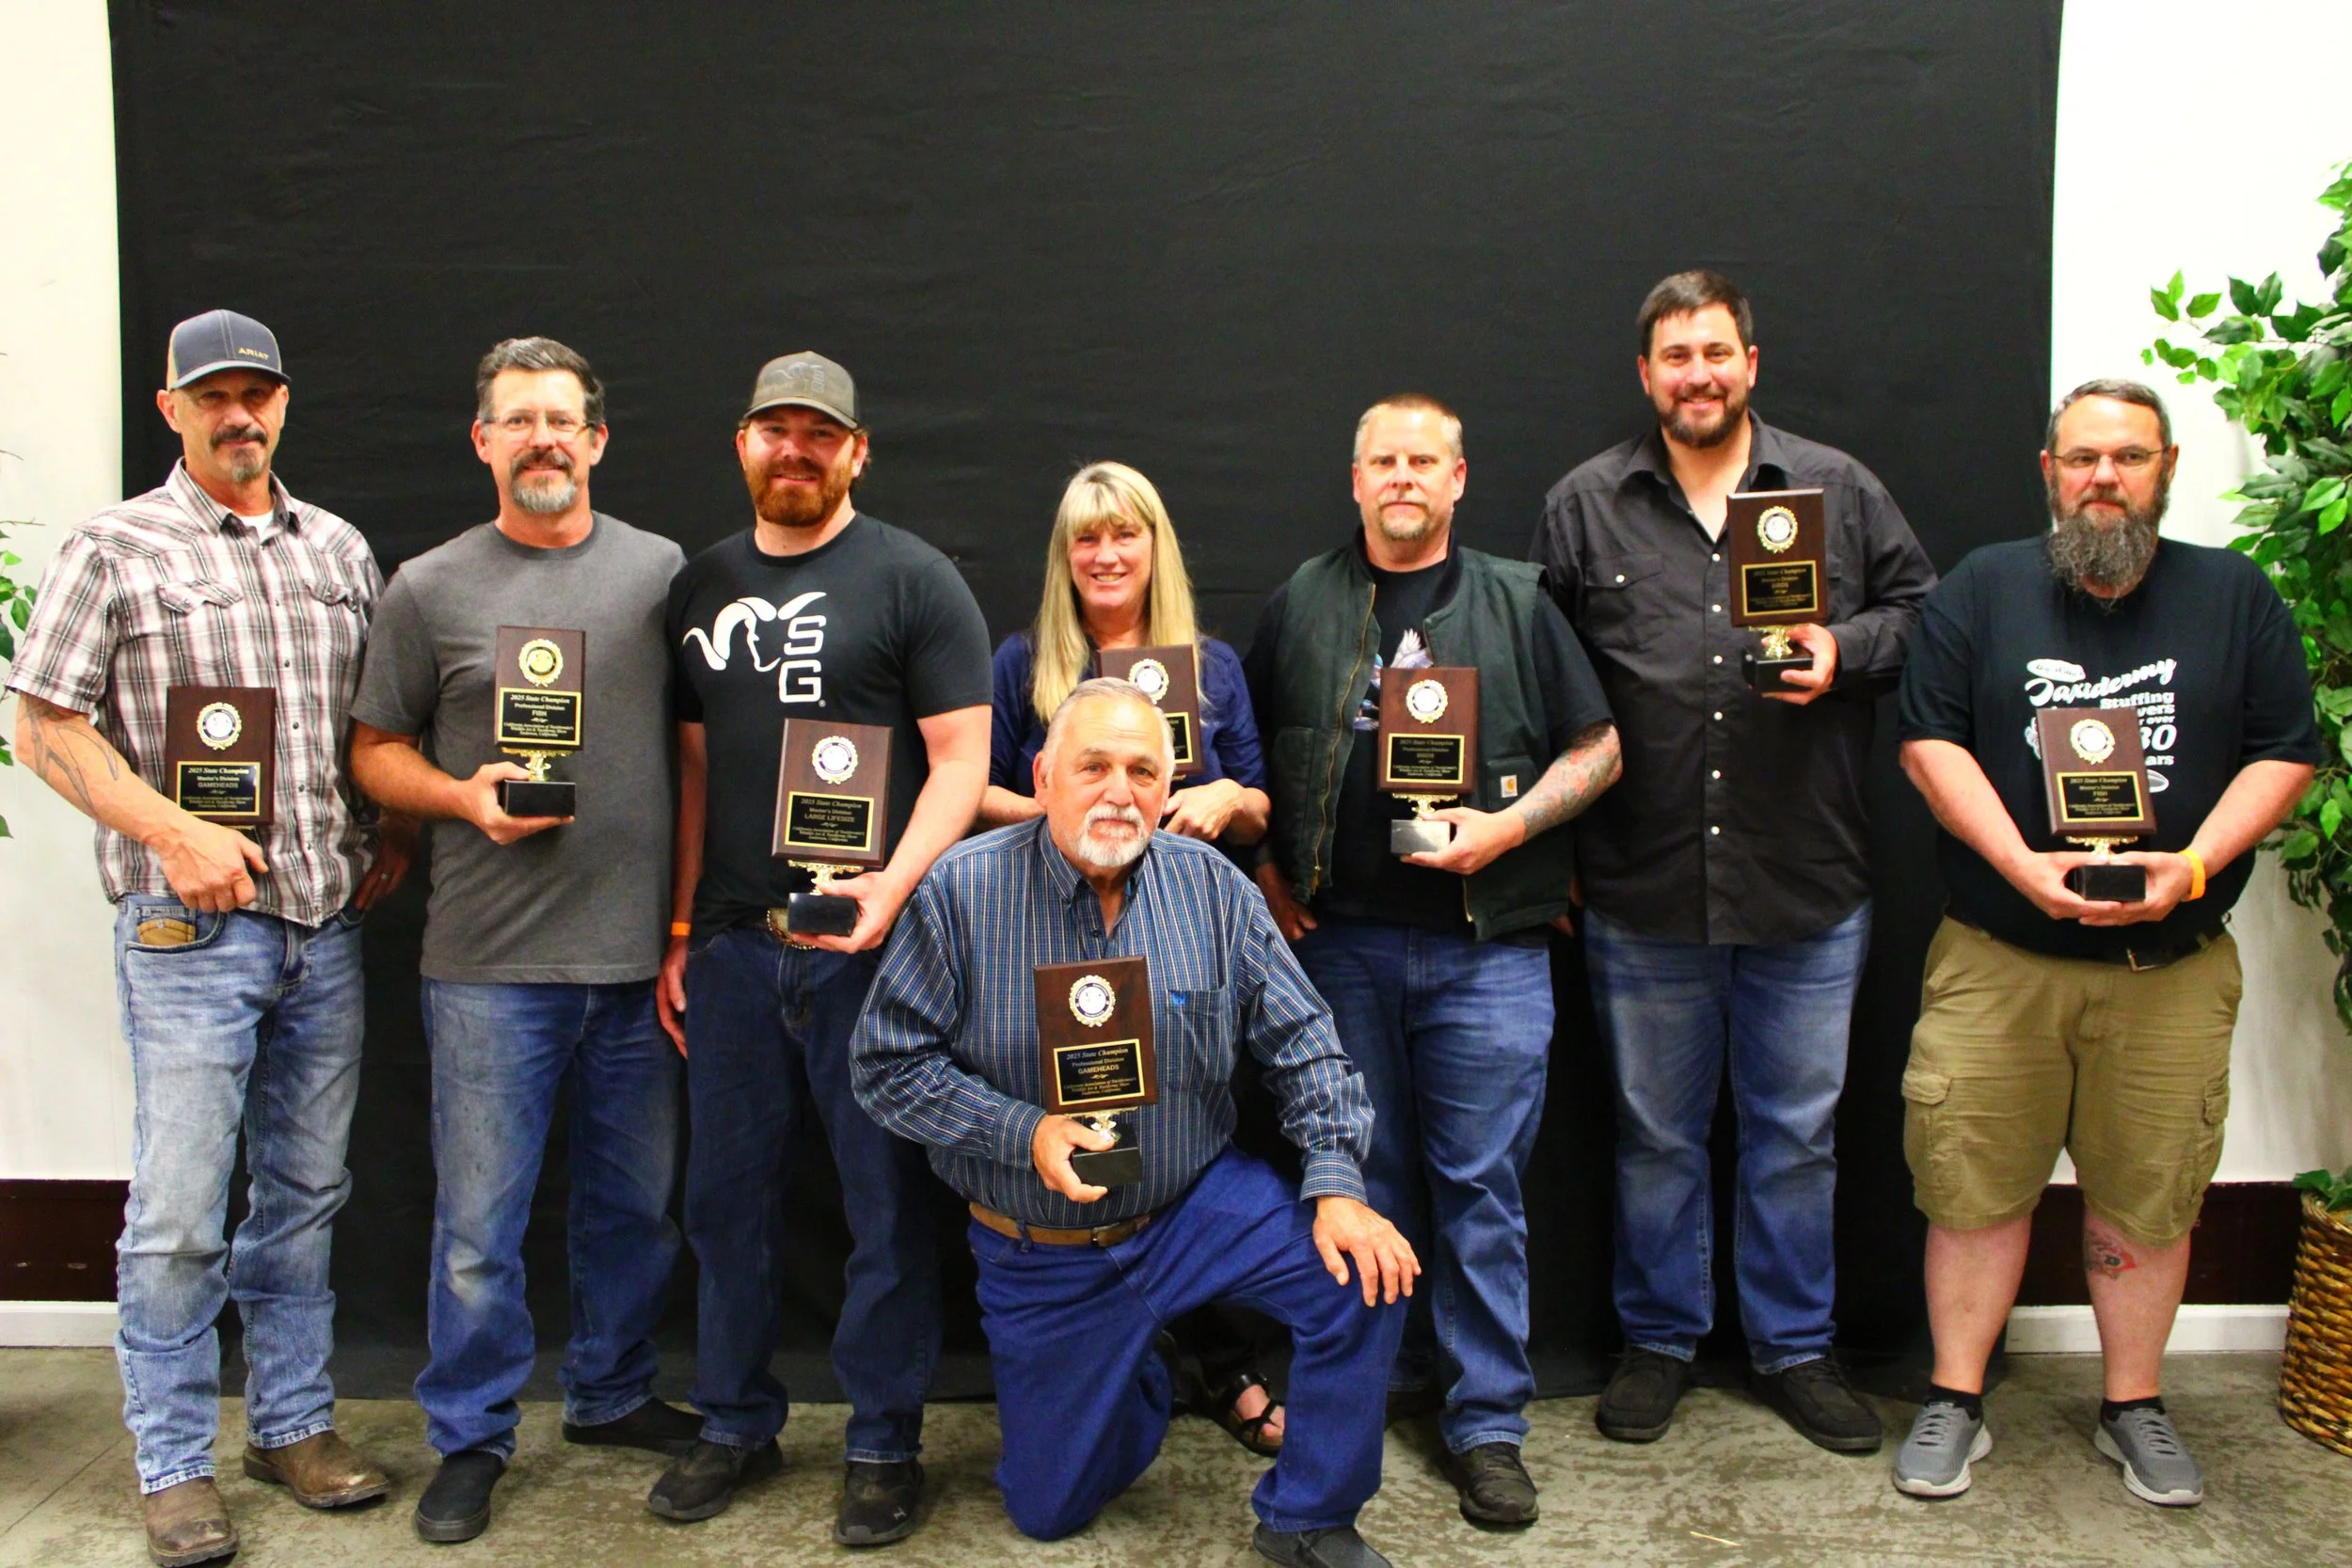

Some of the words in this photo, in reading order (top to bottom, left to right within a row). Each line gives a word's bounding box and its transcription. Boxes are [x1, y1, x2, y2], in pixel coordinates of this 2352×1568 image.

[238, 347, 269, 360] ARIAT
[2025, 658, 2177, 706] Taxidermy
[2100, 692, 2175, 709] Stuffing
[2146, 715, 2175, 724] over
[1098, 1048, 1129, 1056] Champion
[1078, 1065, 1120, 1074] GAMEHEADS
